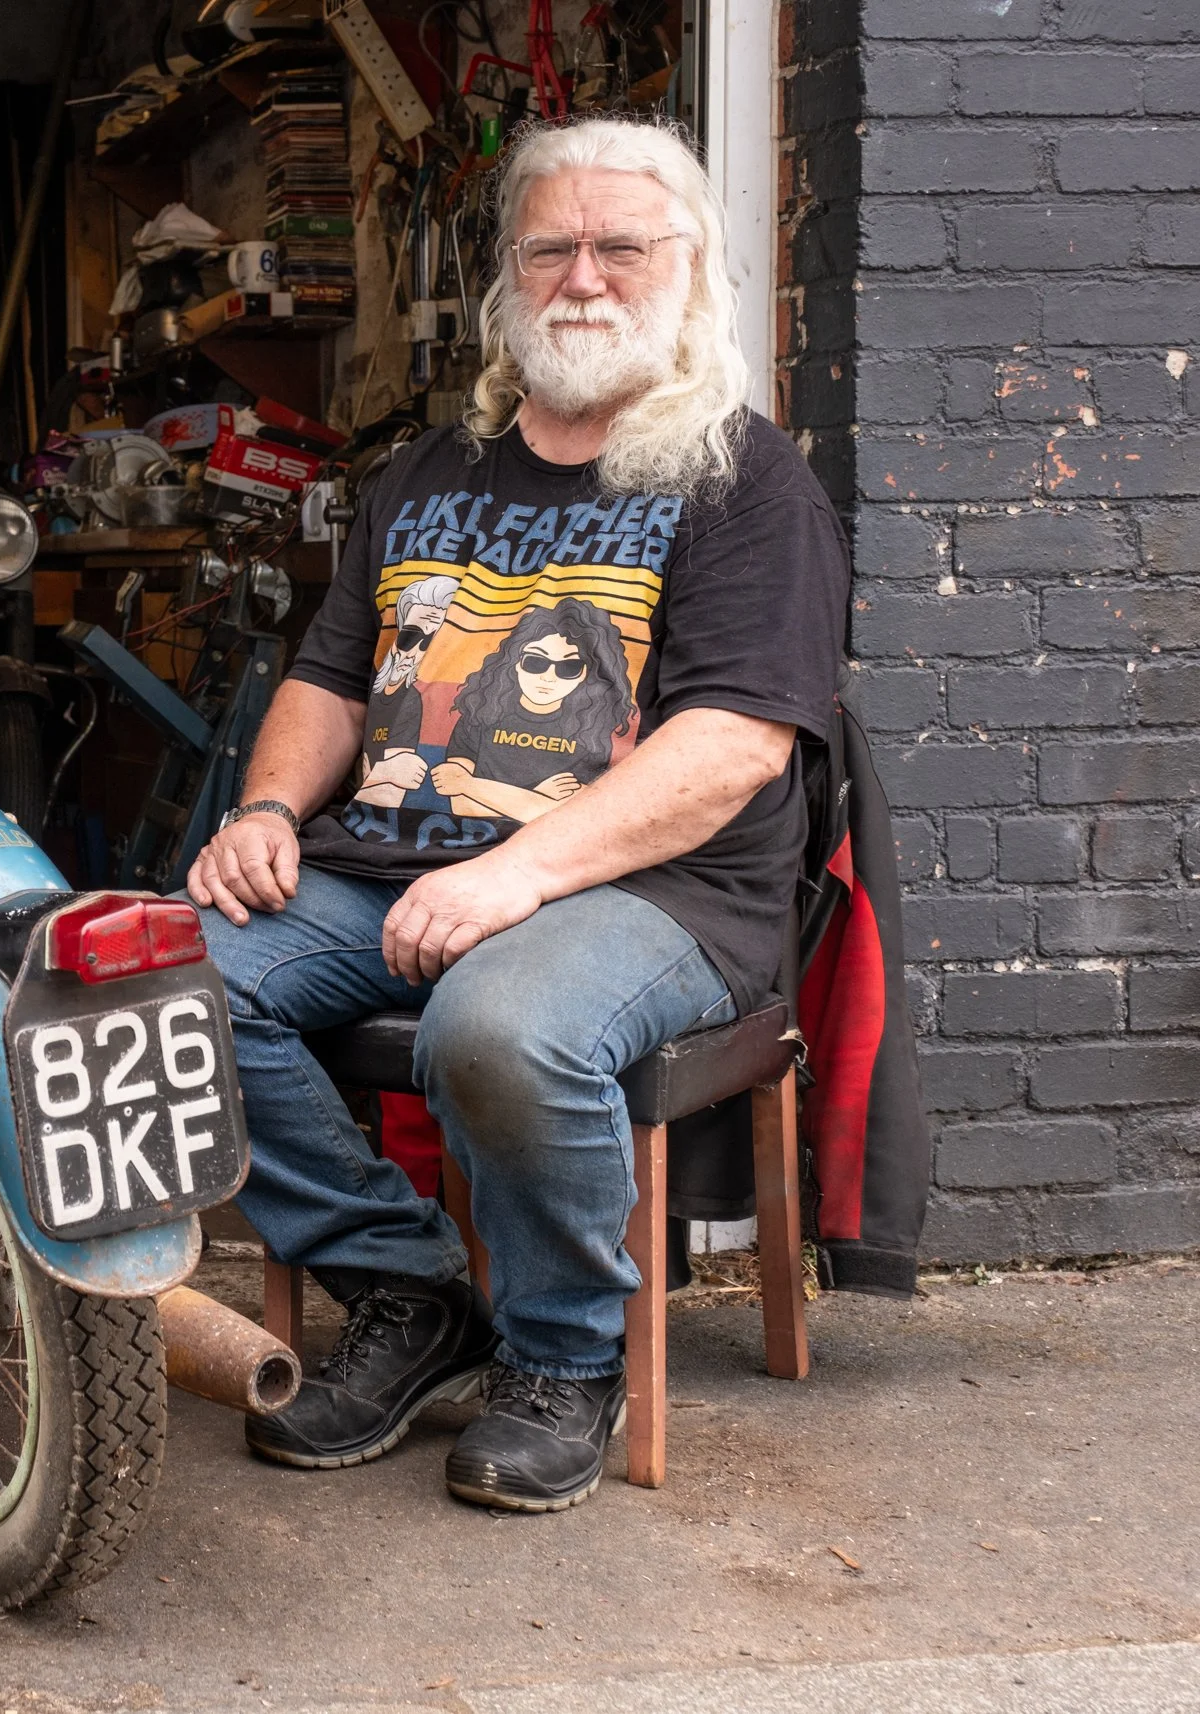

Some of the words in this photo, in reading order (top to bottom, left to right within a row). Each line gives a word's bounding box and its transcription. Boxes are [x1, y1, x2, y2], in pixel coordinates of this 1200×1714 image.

[242, 446, 312, 479] BS
[241, 495, 272, 511] SLA
[492, 495, 683, 545] FATHER
[383, 528, 467, 564] LIKE
[372, 727, 389, 742] JOE
[492, 729, 577, 754] IMOGEN
[31, 999, 216, 1118] 826
[42, 1096, 221, 1226] DKF
